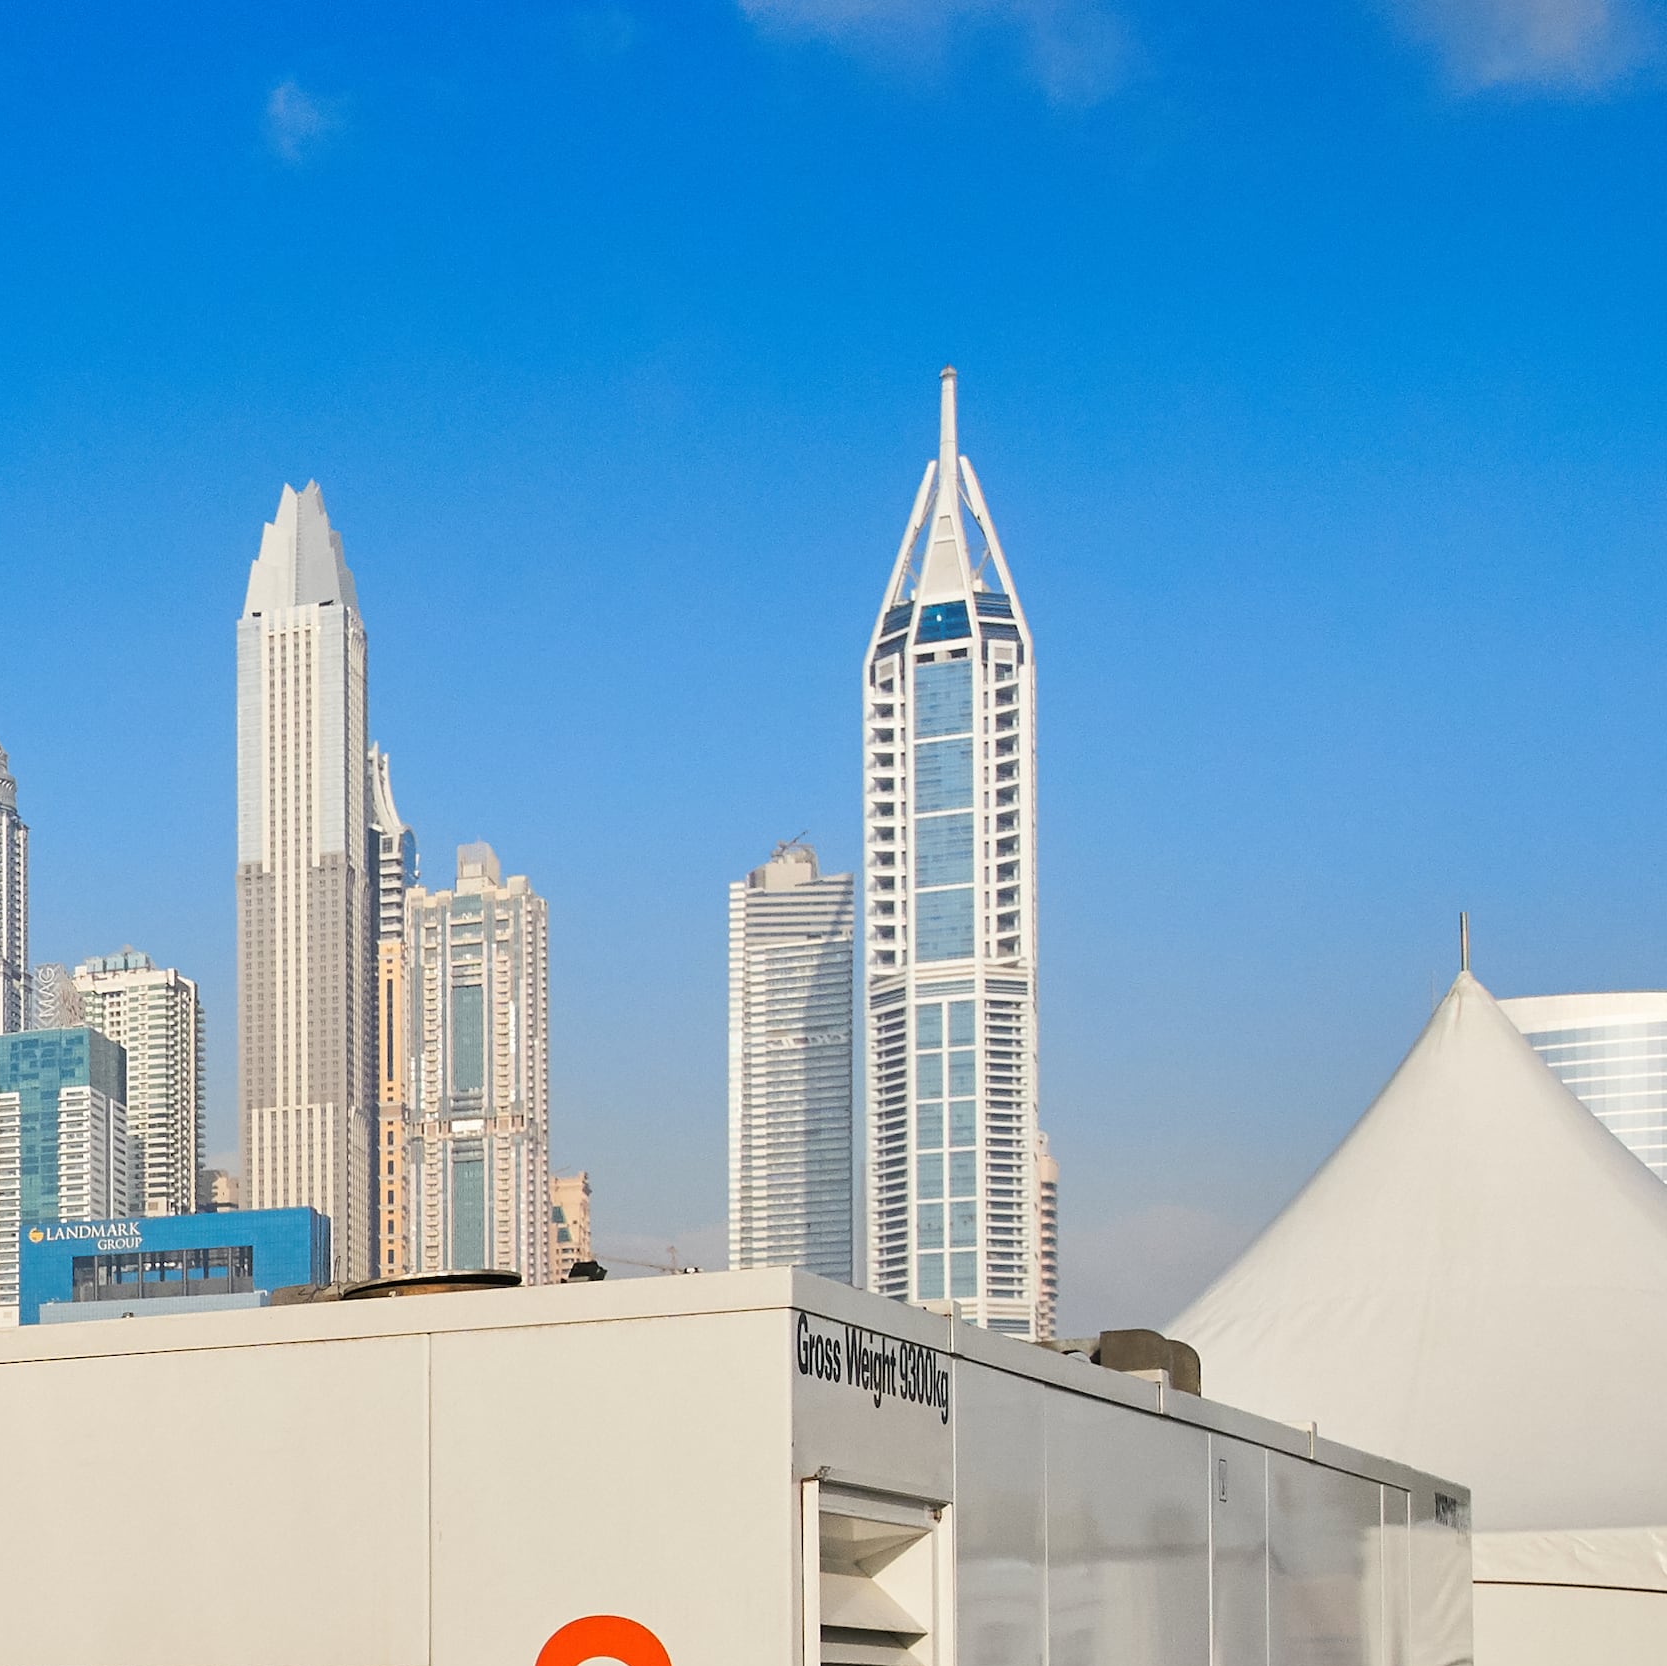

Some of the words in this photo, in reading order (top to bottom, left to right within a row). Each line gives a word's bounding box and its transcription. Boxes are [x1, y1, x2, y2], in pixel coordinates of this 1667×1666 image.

[47, 1222, 141, 1241] LANDMARK
[97, 1237, 143, 1251] GROUP
[797, 1312, 841, 1383] Gross
[845, 1326, 896, 1408] Weight
[900, 1342, 949, 1424] 9300kg
